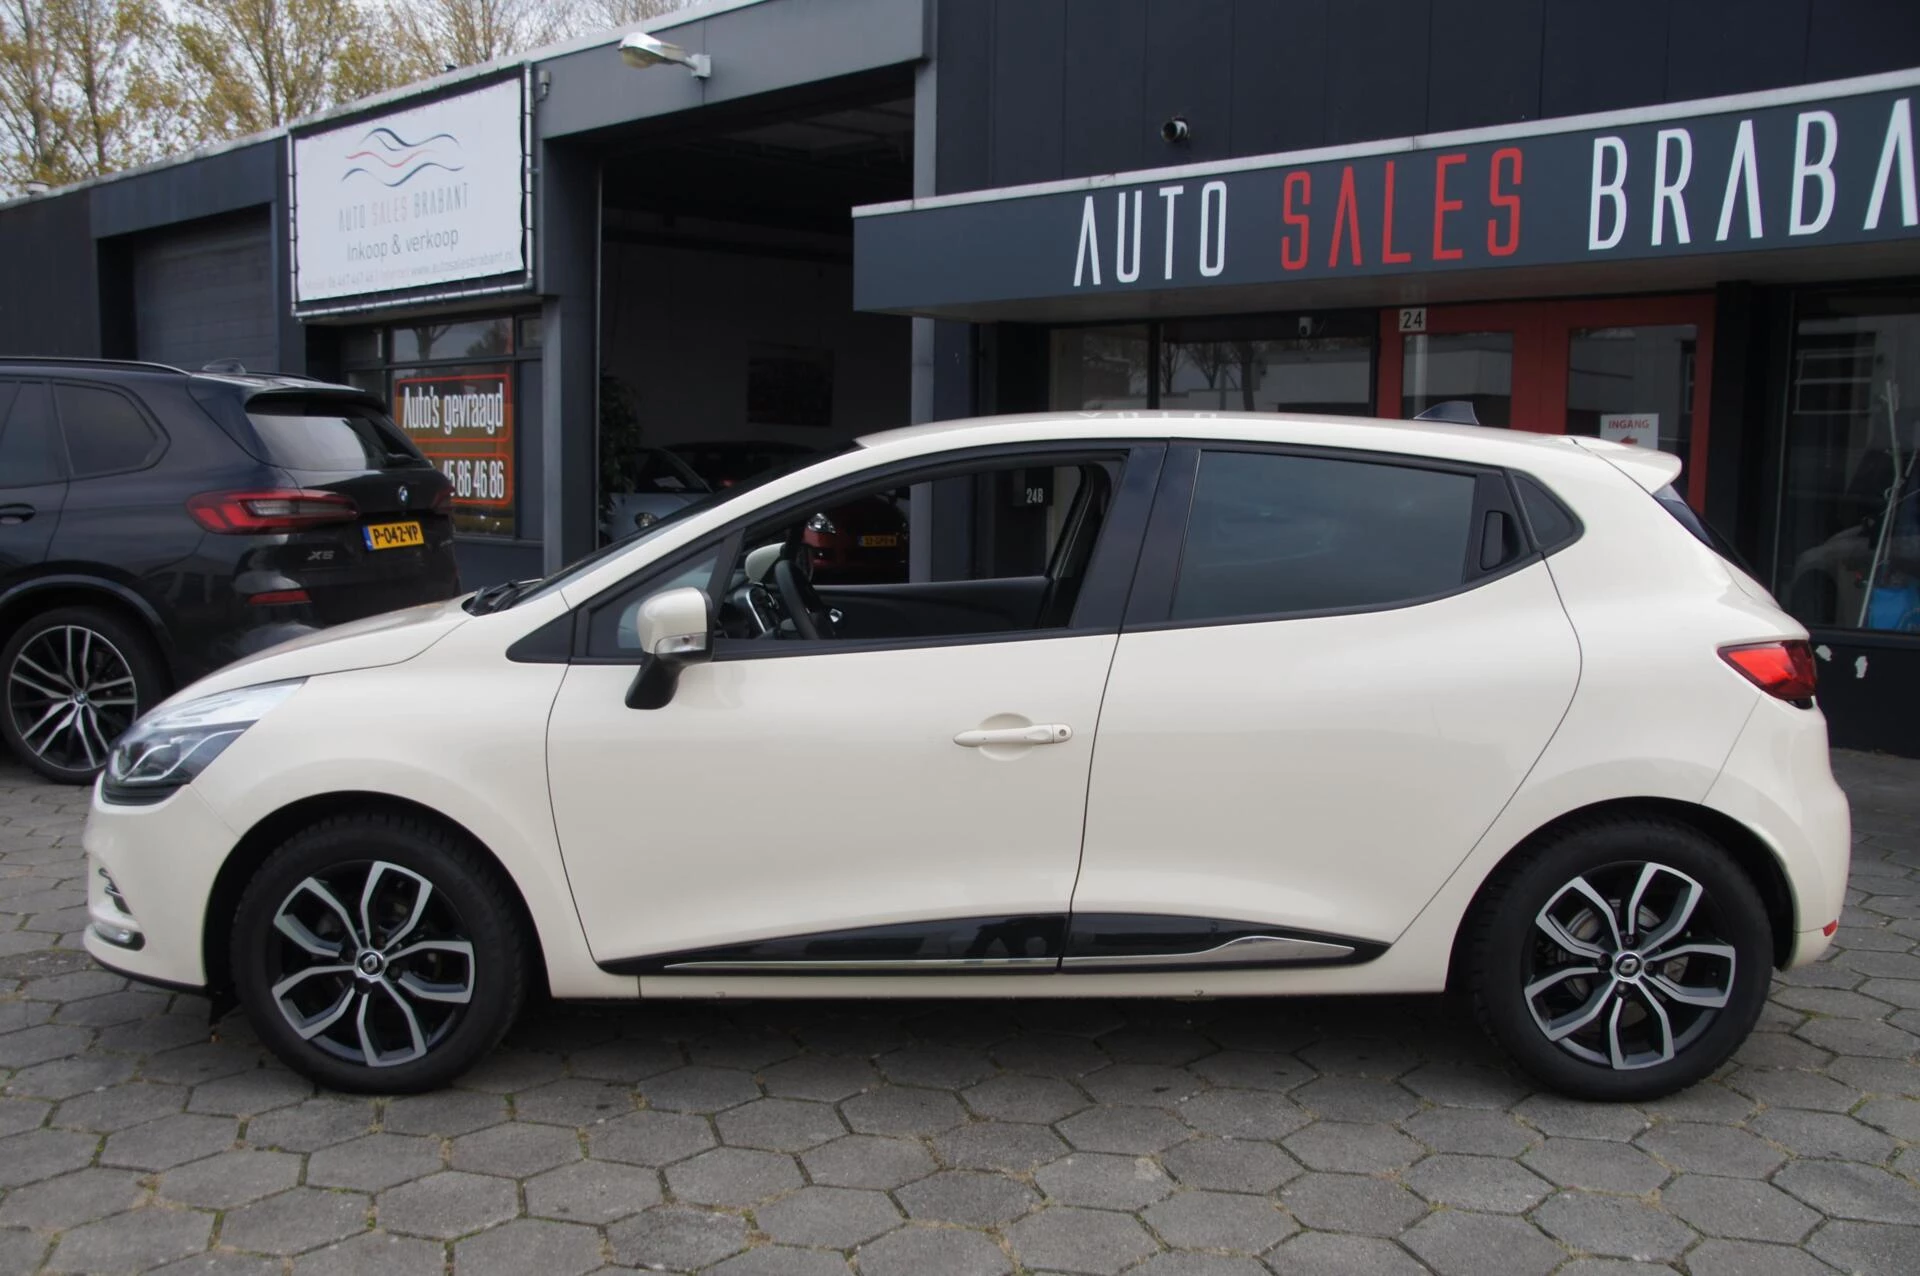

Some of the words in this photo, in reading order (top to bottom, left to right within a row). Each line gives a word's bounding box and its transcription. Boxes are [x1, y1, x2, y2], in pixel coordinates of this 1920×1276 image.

[338, 205, 366, 232] AUTO
[372, 195, 408, 226] SALES
[414, 182, 469, 219] BRABANT
[1073, 181, 1228, 287] AUTO
[1281, 147, 1523, 270] SALES
[1588, 98, 1919, 251] BRABA
[347, 240, 388, 263] Inkoop
[391, 234, 402, 256] &
[405, 228, 459, 253] verkoop
[1402, 311, 1424, 329] 24
[403, 386, 440, 428] Auto's
[444, 383, 504, 435] gevraagd
[1608, 419, 1649, 430] INGANG
[457, 460, 472, 497] 86
[473, 460, 488, 498] 46
[489, 460, 504, 499] 86
[373, 526, 419, 544] P-042-VP
